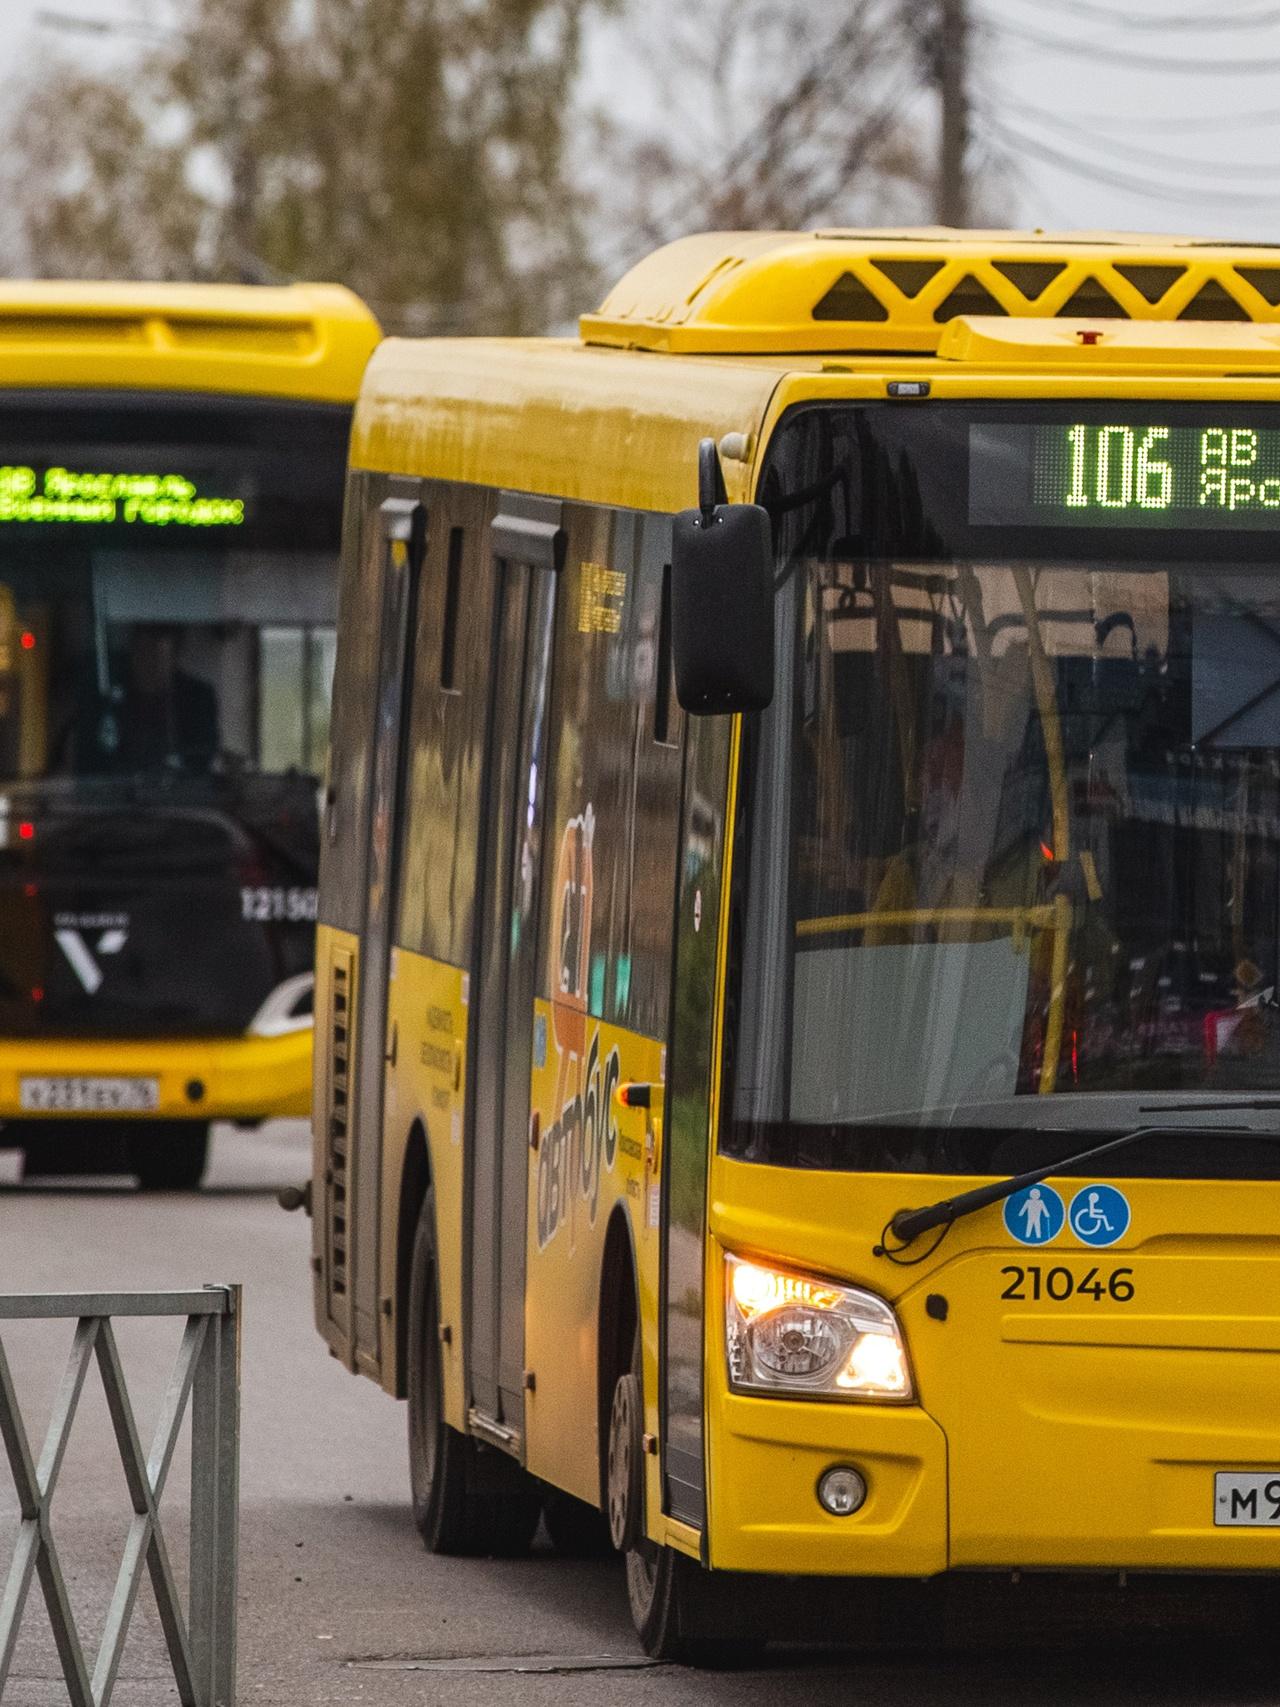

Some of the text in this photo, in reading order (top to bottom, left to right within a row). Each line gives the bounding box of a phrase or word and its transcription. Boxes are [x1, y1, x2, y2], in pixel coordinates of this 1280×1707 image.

[1200, 427, 1257, 466] АВ
[1066, 424, 1172, 509] 106
[1000, 1265, 1135, 1302] 21046
